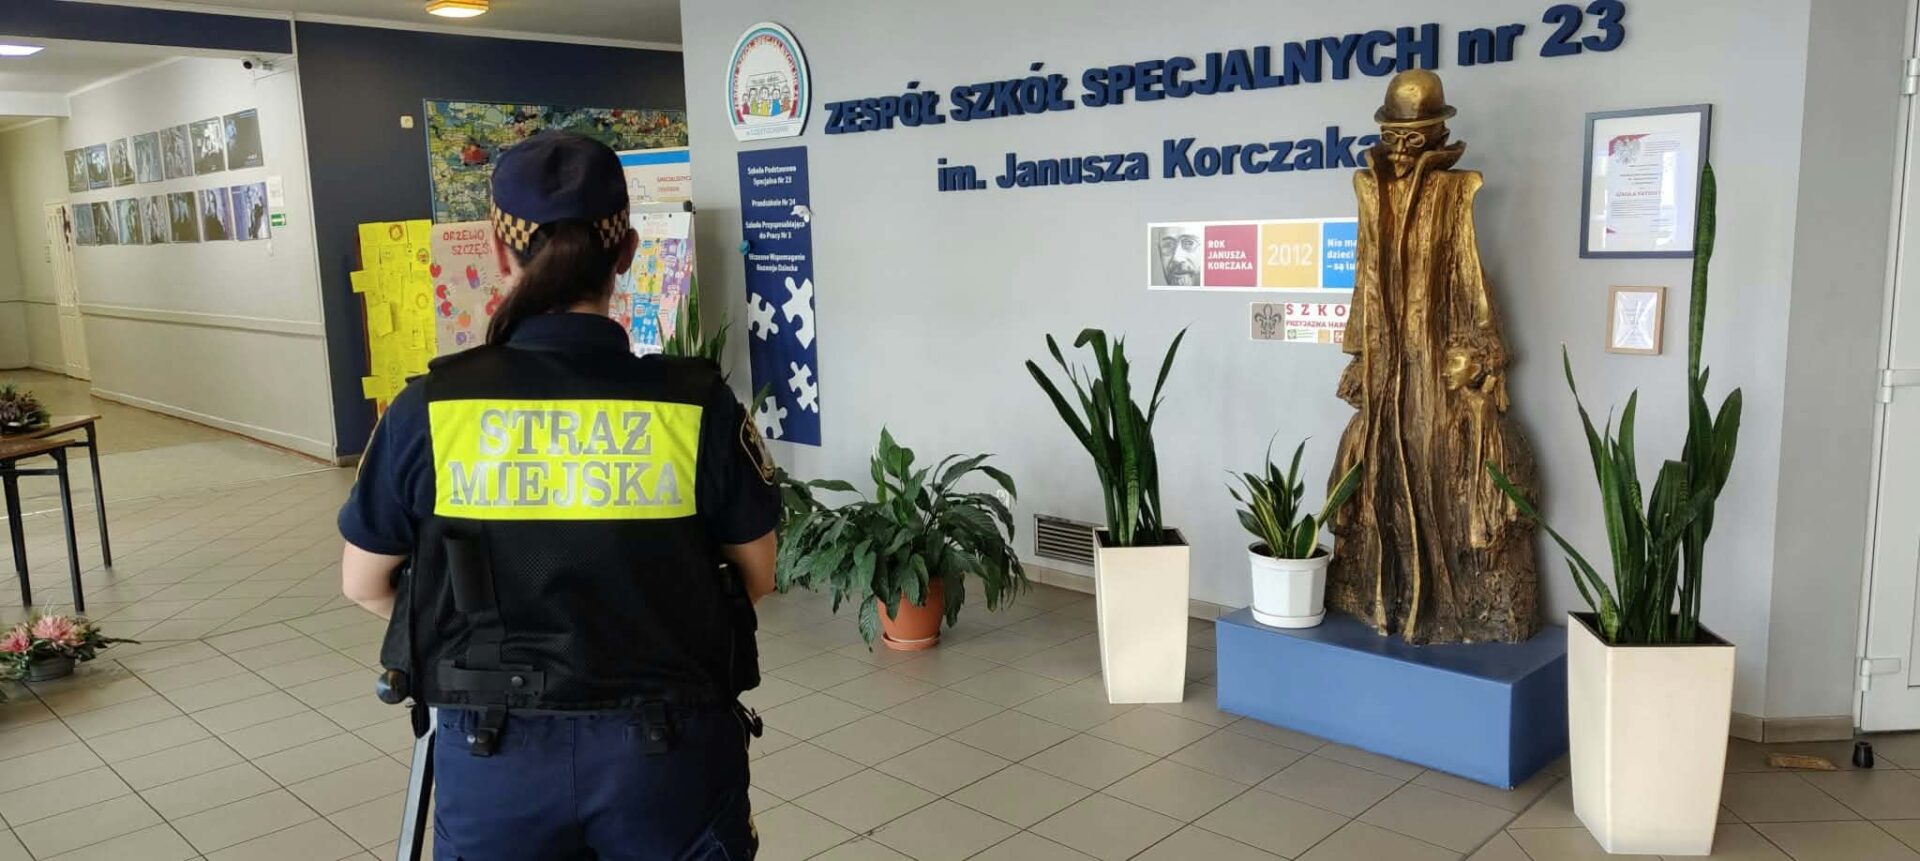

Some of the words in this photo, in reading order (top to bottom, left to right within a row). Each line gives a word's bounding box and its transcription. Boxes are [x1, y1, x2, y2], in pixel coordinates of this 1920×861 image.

[824, 81, 946, 135] ZESPÓŁ
[950, 62, 1075, 122] SZKÓŁ
[1081, 22, 1439, 109] SPECJALNYCH
[1458, 23, 1525, 66] nr
[1539, 0, 1626, 58] 23
[937, 157, 987, 192] im.
[995, 151, 1149, 190] Janusza
[766, 231, 780, 241] Pracy
[1327, 238, 1343, 248] Nie
[450, 241, 493, 259] SZCZĘŚ
[1207, 239, 1226, 249] ROK
[1207, 250, 1247, 259] JANUSZA
[1267, 243, 1313, 266] 2012
[1327, 250, 1355, 259] dzieci
[1207, 261, 1254, 270] KORCZAKA
[1286, 303, 1346, 317] SZKO
[479, 409, 652, 457] STRAŻ
[448, 460, 683, 507] MIEJSKA
